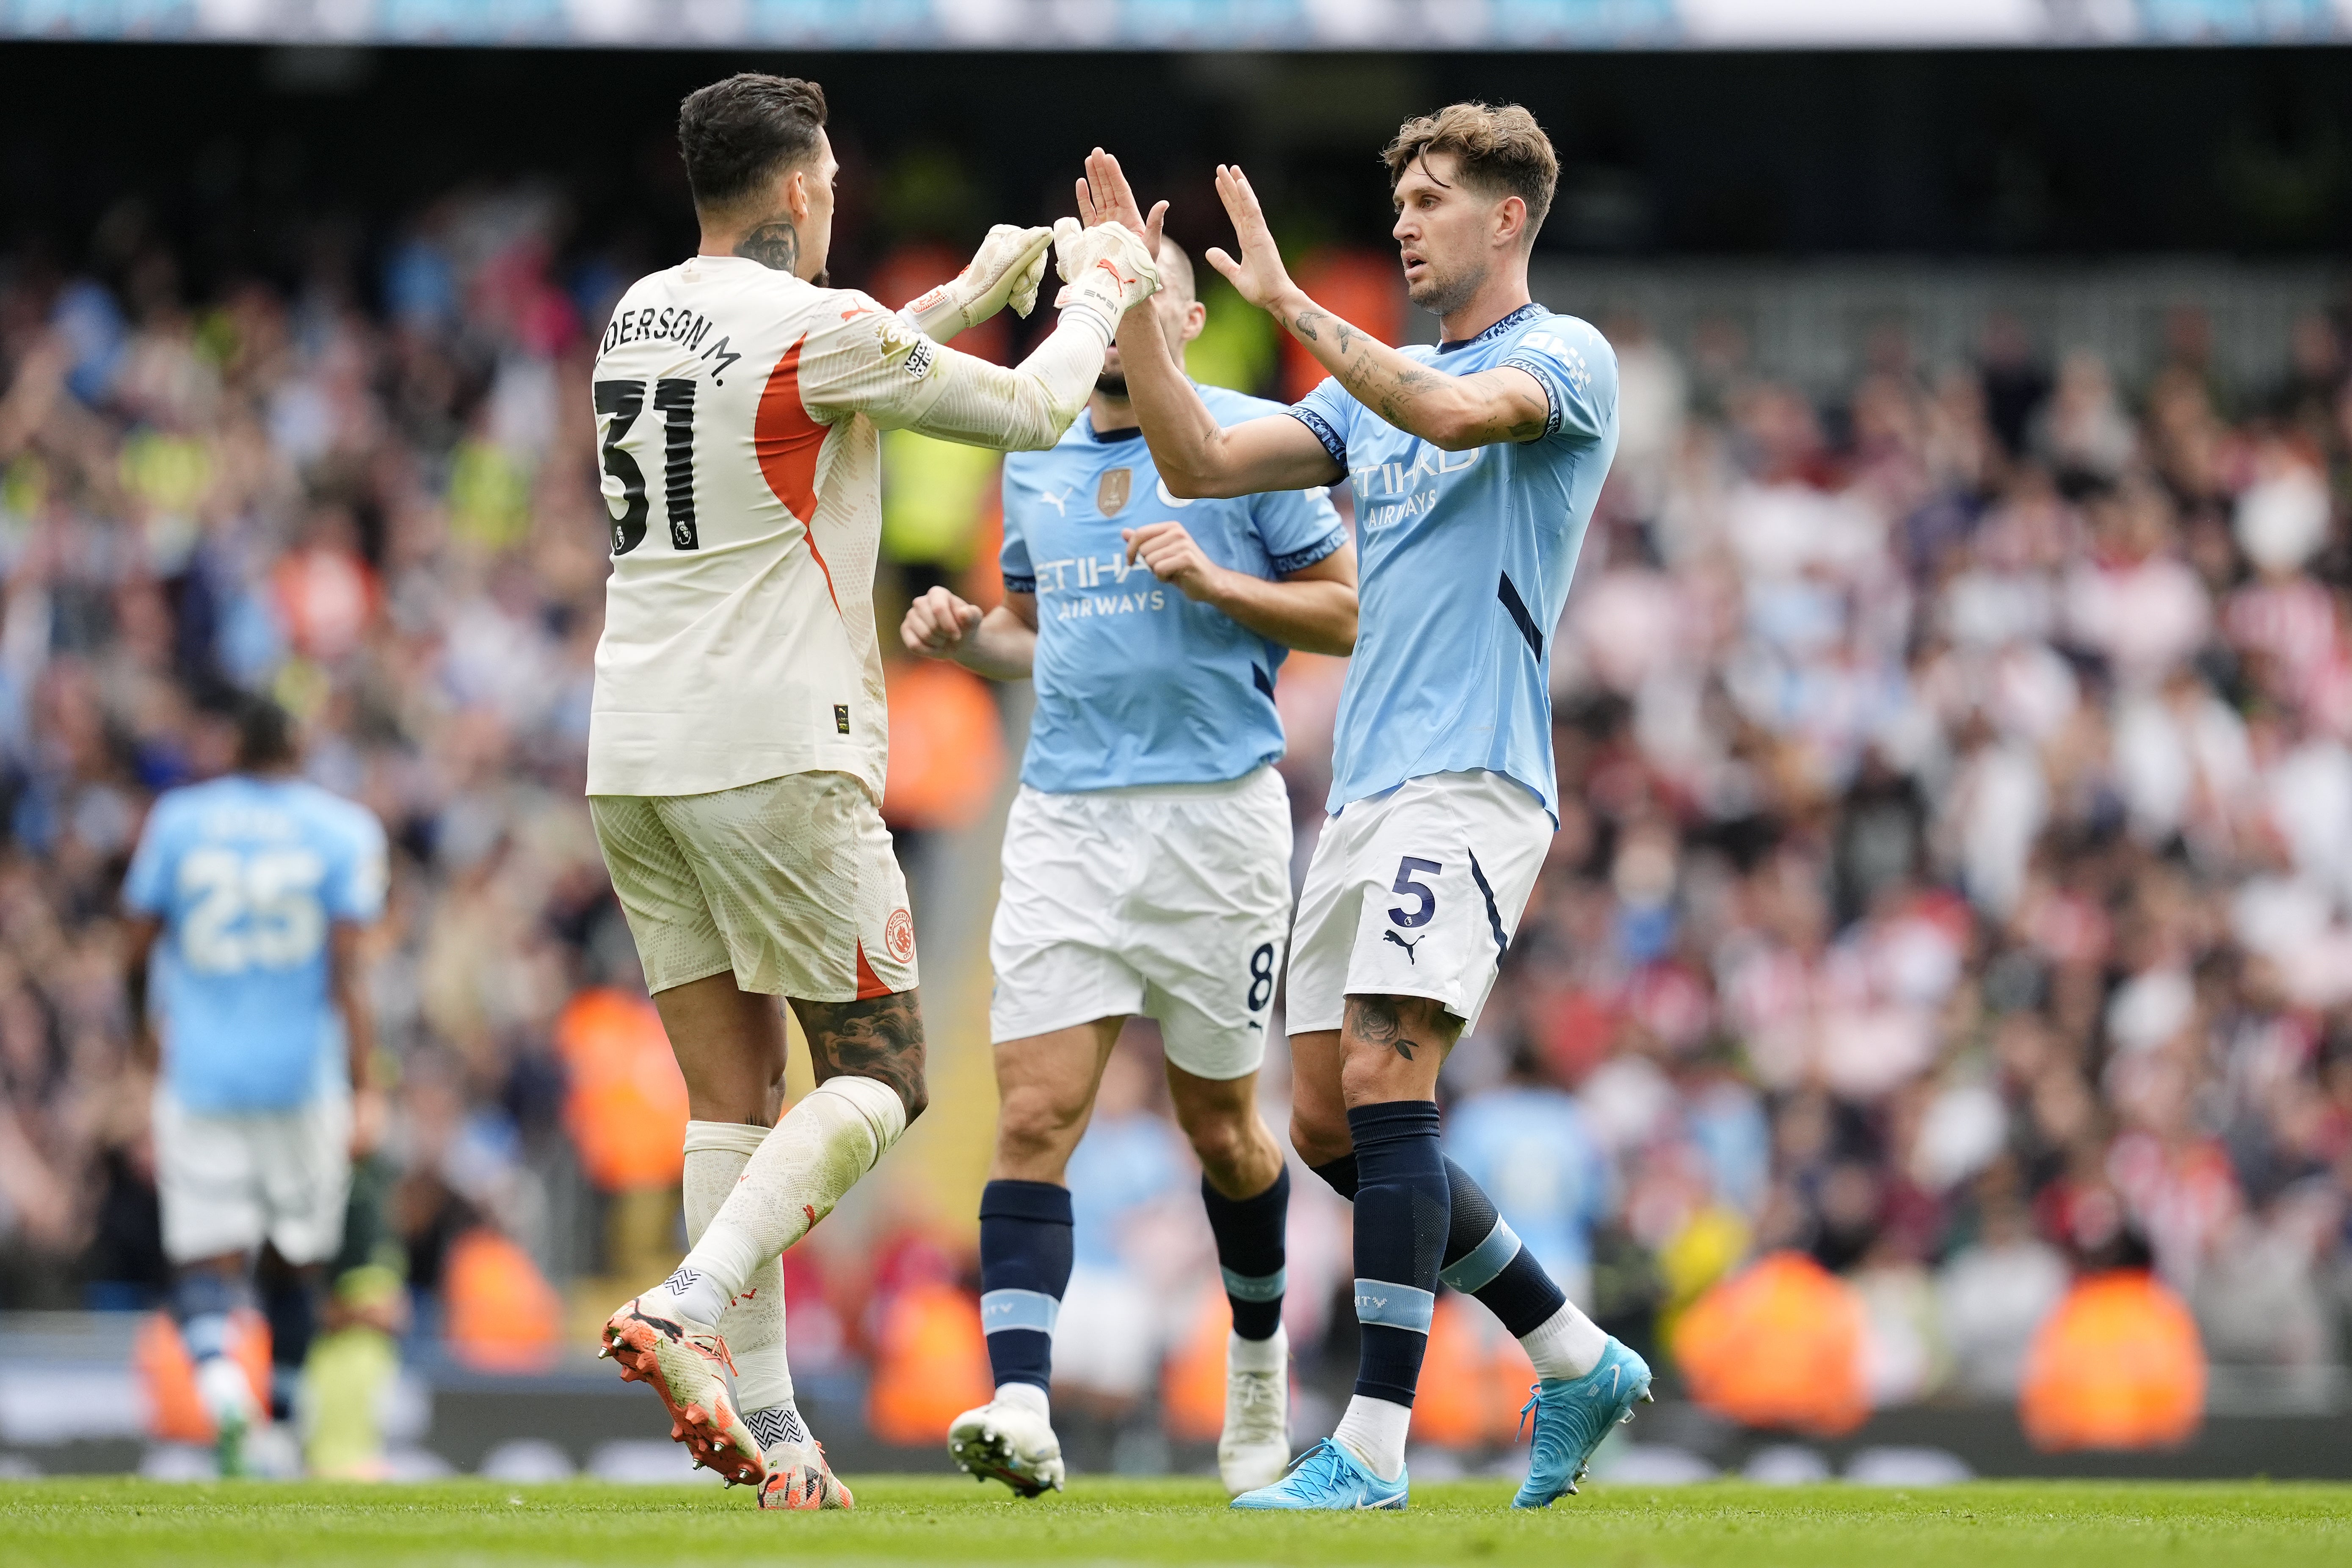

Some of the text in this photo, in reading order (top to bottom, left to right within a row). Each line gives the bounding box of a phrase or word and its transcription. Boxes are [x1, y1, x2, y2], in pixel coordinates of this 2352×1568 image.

[594, 307, 742, 386] DERSON M.
[903, 355, 920, 374] No
[911, 360, 927, 380] for
[594, 379, 699, 556] 31
[1368, 489, 1436, 527] AIRWAYS
[1035, 552, 1152, 593] ETIHA
[1057, 590, 1164, 621] AIRWAYS
[178, 843, 329, 974] 25
[1388, 856, 1442, 928] 5
[1248, 942, 1274, 1011] 8
